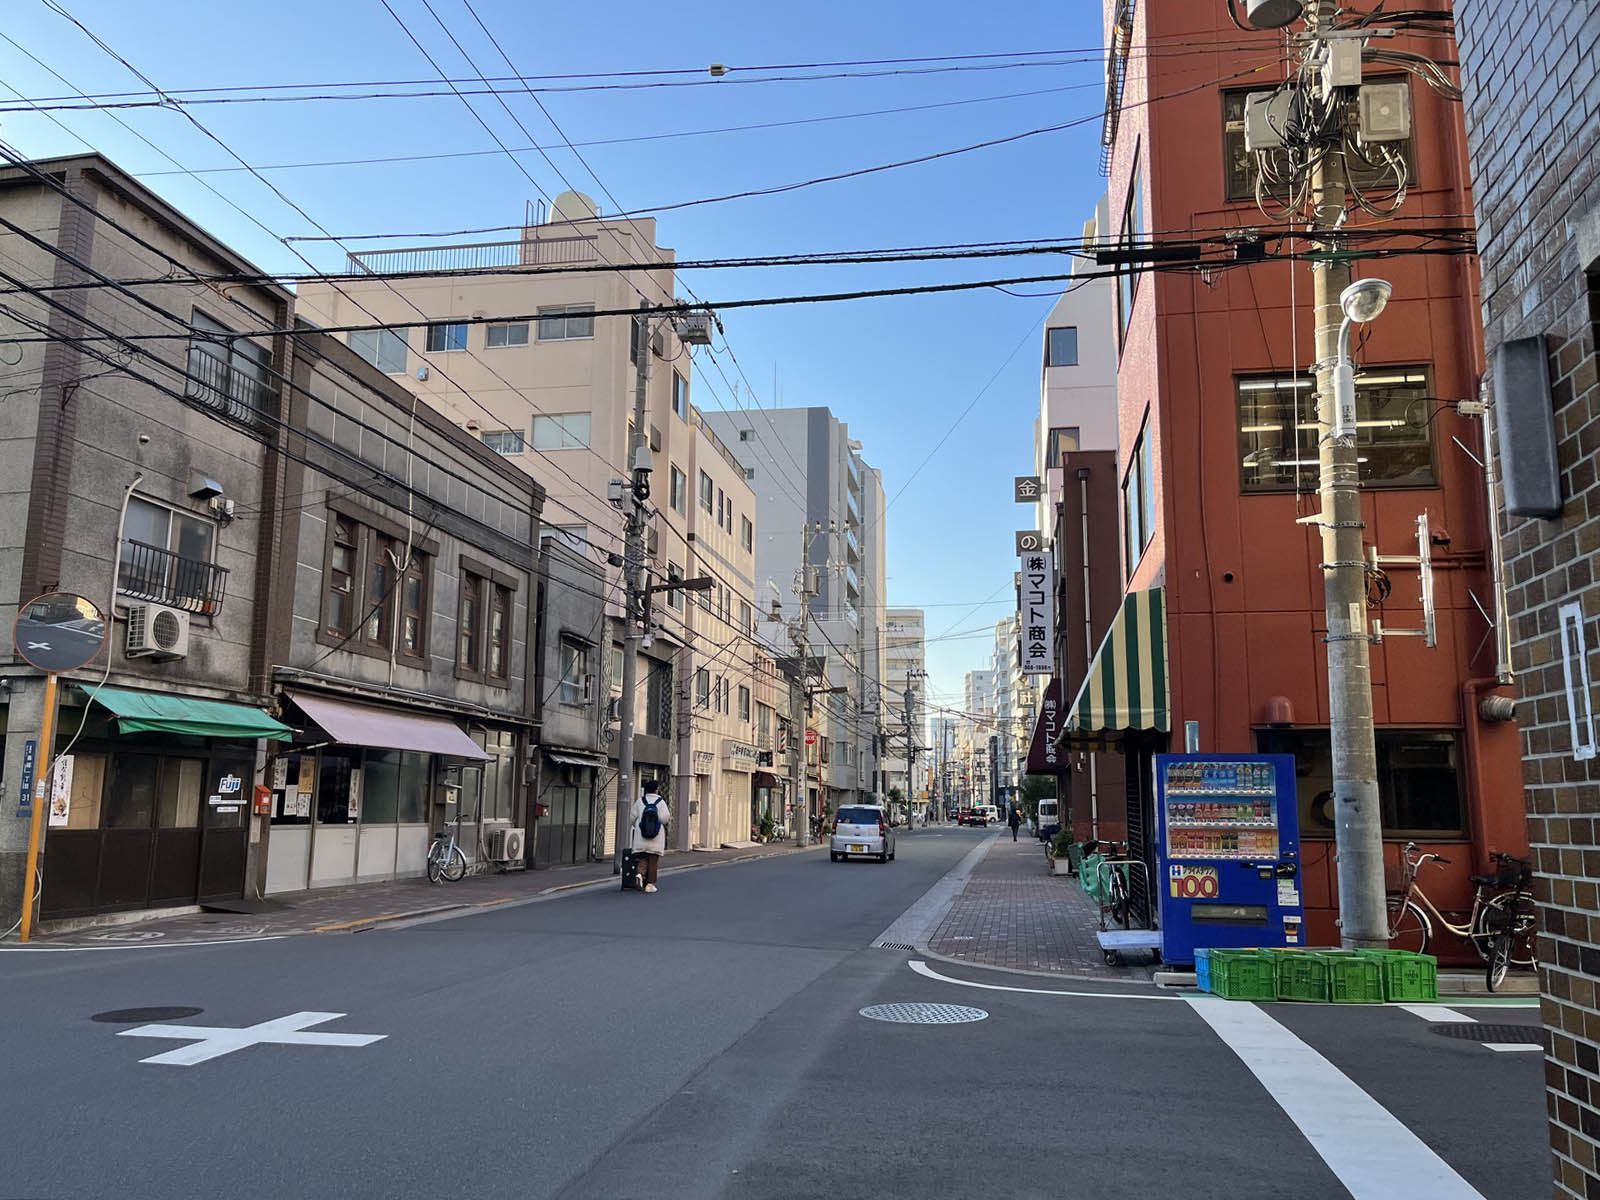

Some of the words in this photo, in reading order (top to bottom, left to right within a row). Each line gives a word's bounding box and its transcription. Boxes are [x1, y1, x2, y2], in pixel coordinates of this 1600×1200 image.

[1018, 480, 1038, 497] 金
[1020, 535, 1038, 550] の
[1019, 691, 1034, 706] 社
[221, 779, 240, 791] Fuji
[1172, 875, 1217, 897] 100
